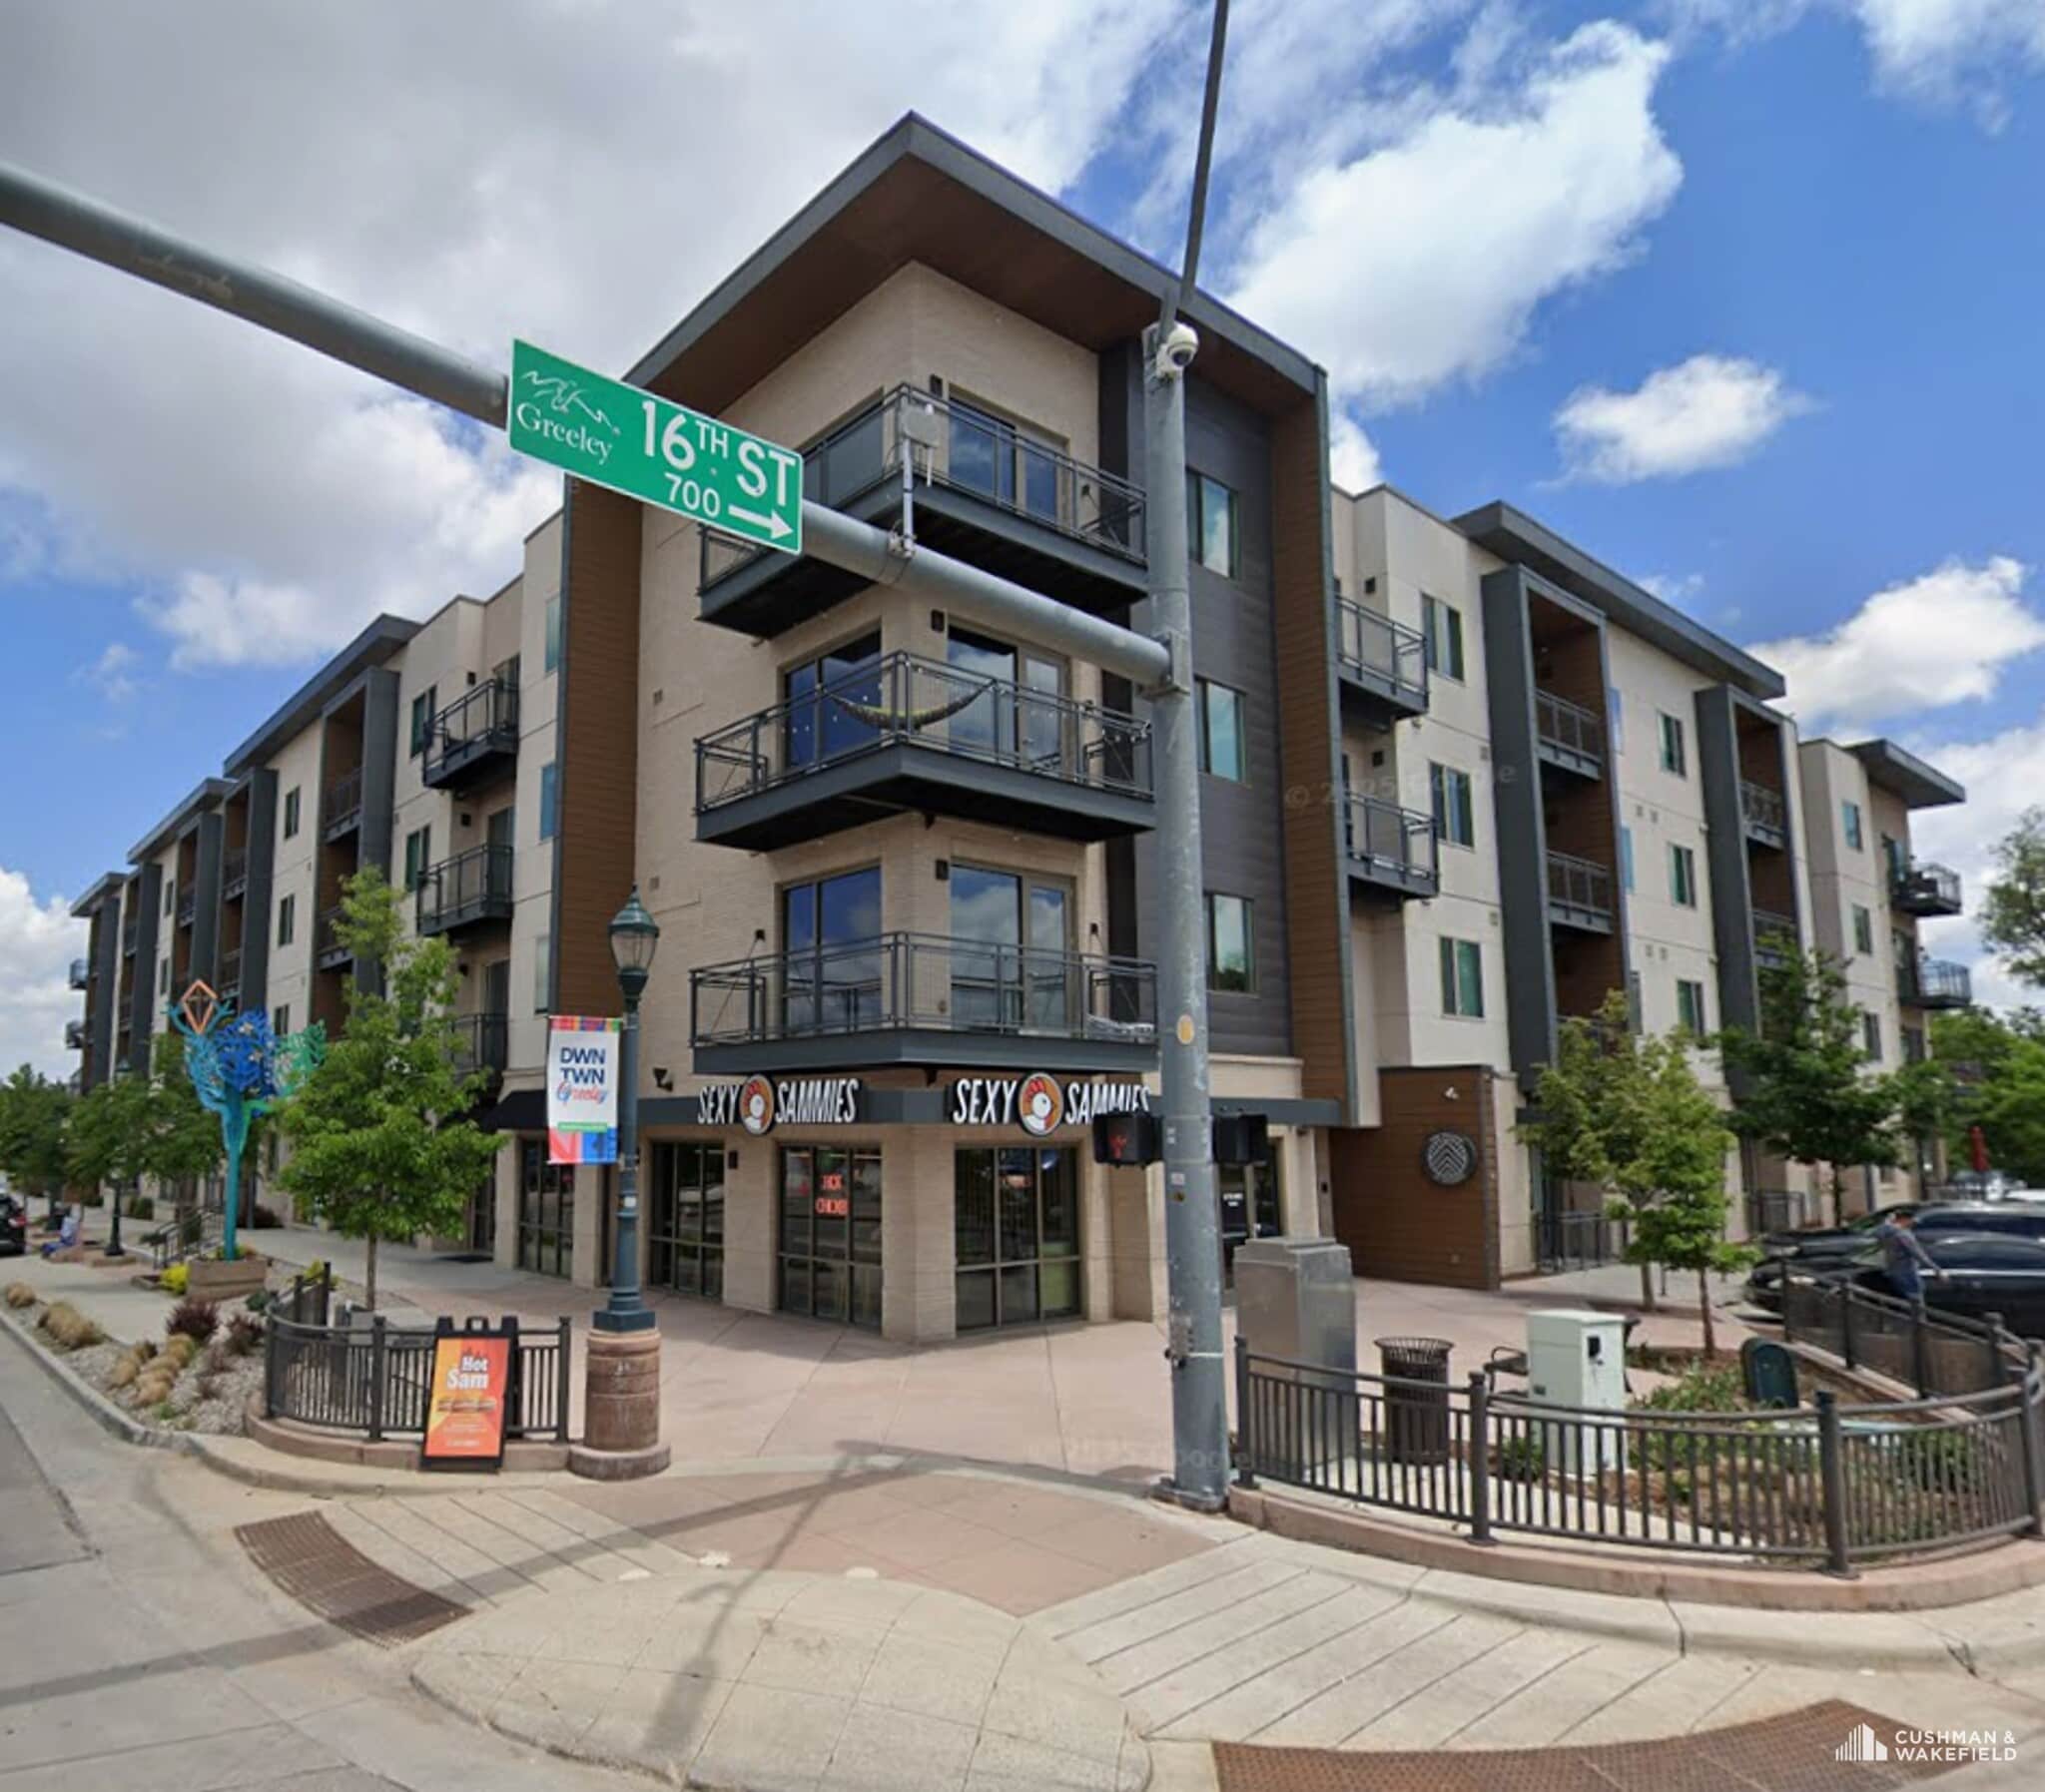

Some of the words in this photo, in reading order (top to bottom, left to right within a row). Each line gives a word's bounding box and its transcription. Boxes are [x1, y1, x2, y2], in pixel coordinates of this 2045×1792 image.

[516, 401, 613, 465] Greeley
[664, 471, 721, 518] 700
[736, 441, 796, 506] ST
[559, 1067, 605, 1085] TWN
[560, 1047, 606, 1065] DWN
[697, 1084, 741, 1125] SEXY
[775, 1077, 859, 1124] SAMMIES
[953, 1078, 1018, 1125] SEXY
[447, 1369, 490, 1390] Sam
